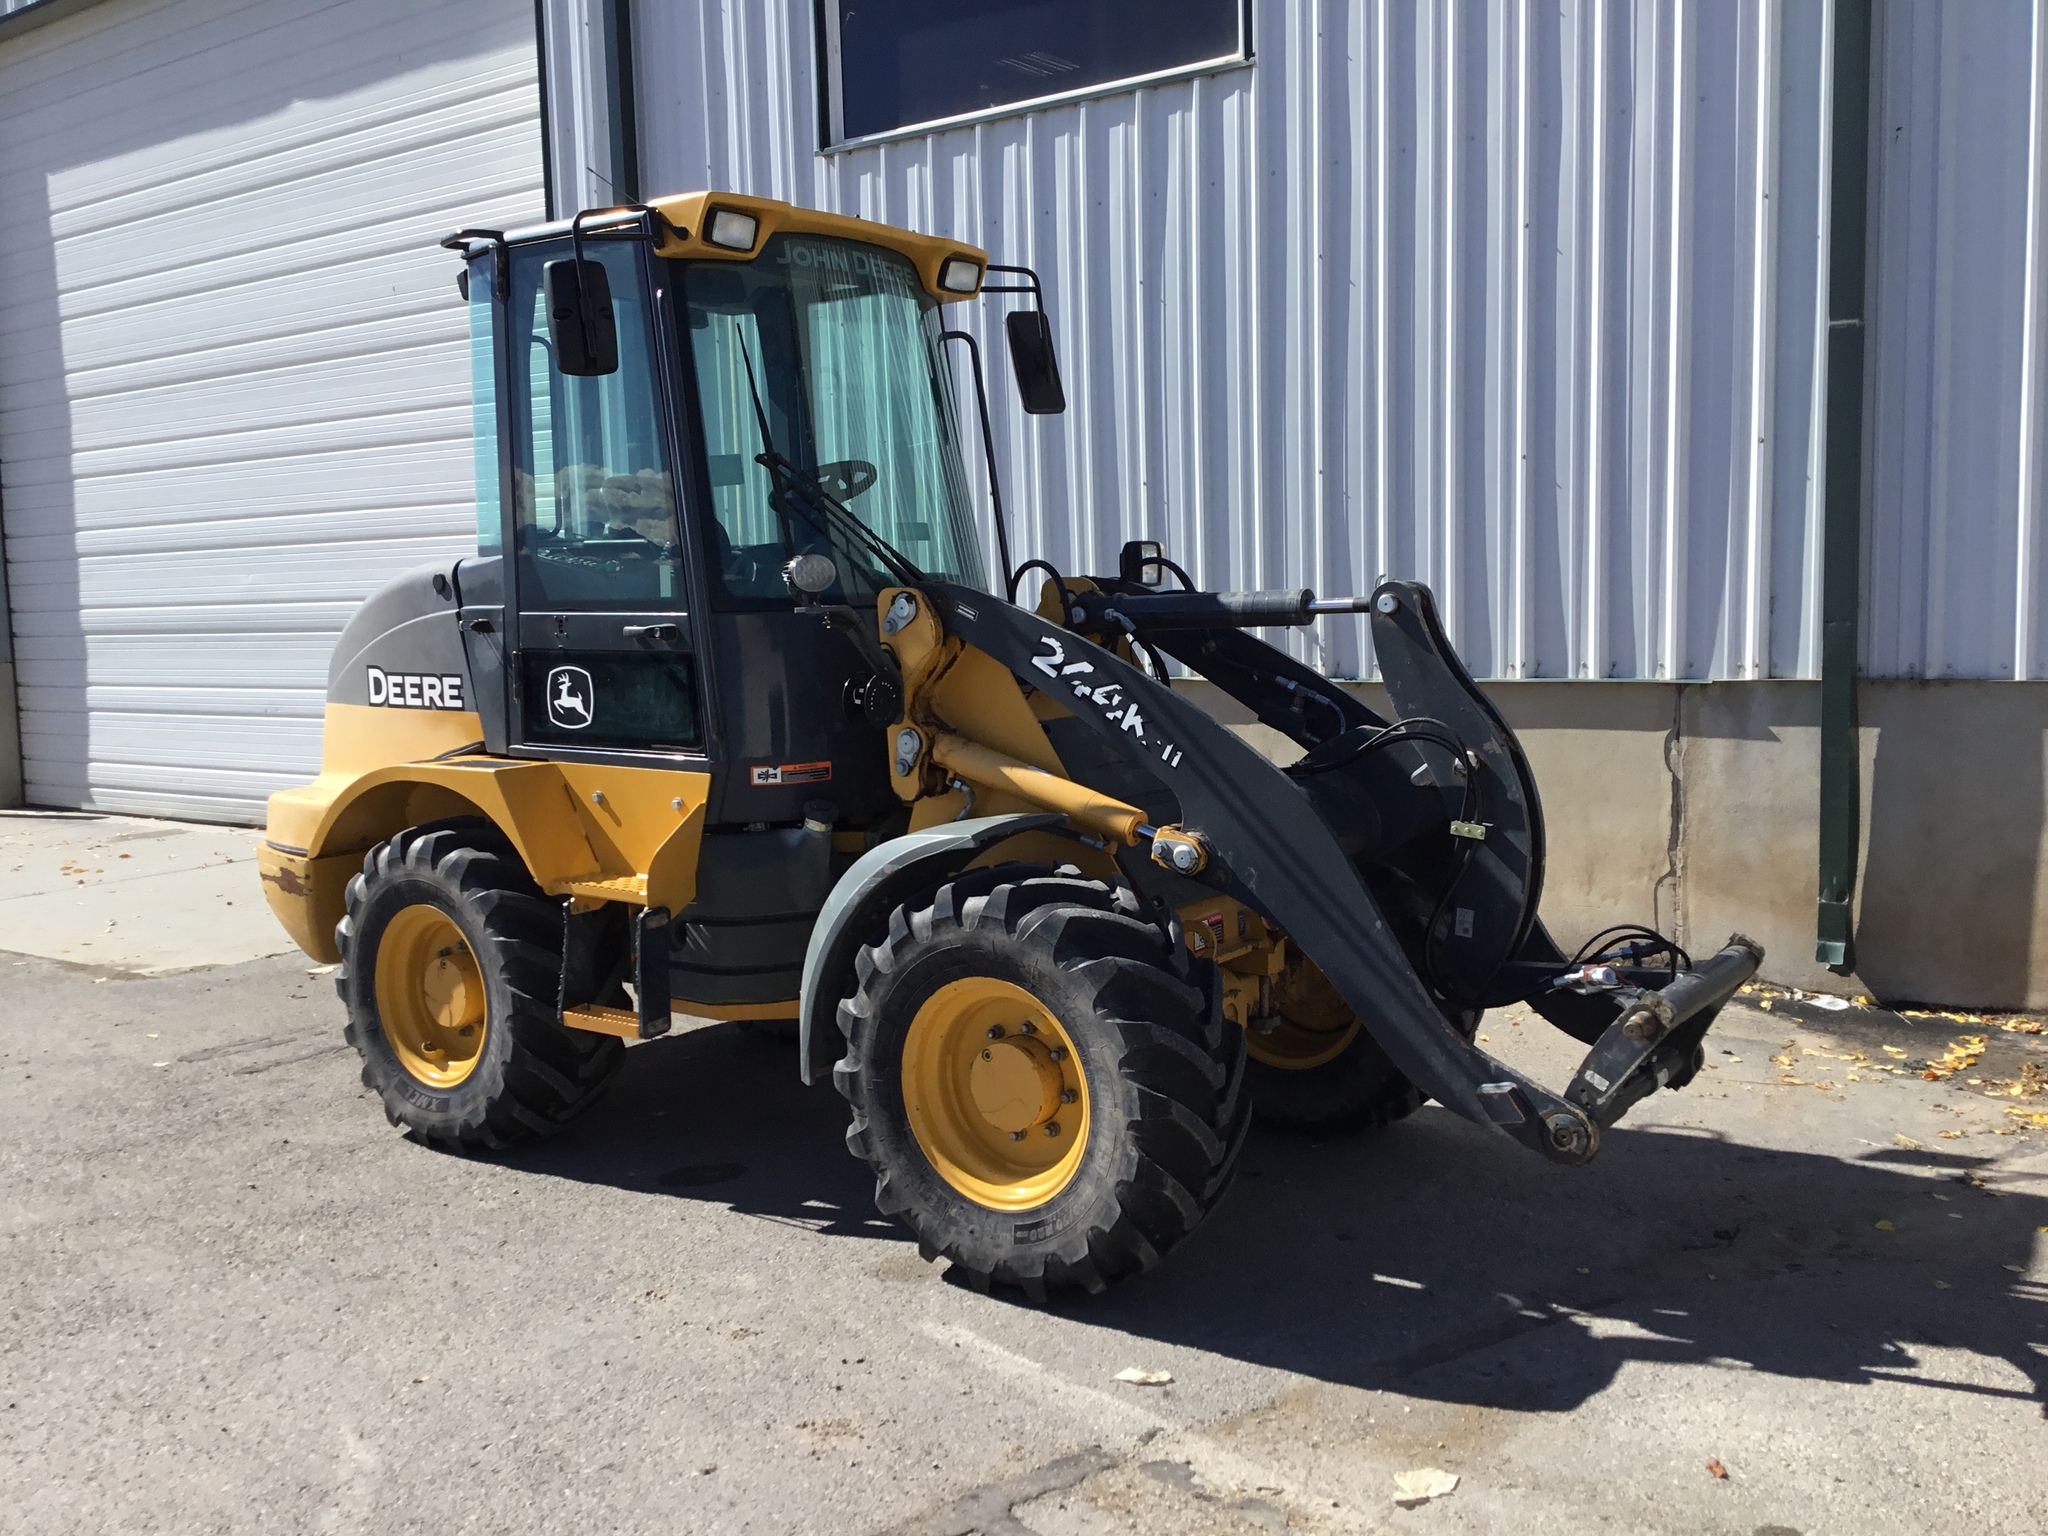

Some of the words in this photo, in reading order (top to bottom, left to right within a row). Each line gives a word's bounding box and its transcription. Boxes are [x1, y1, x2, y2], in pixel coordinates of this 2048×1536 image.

[777, 240, 848, 271] JOHN
[852, 251, 914, 286] DEERE
[367, 667, 463, 708] DEERE
[404, 1087, 440, 1111] XMCL
